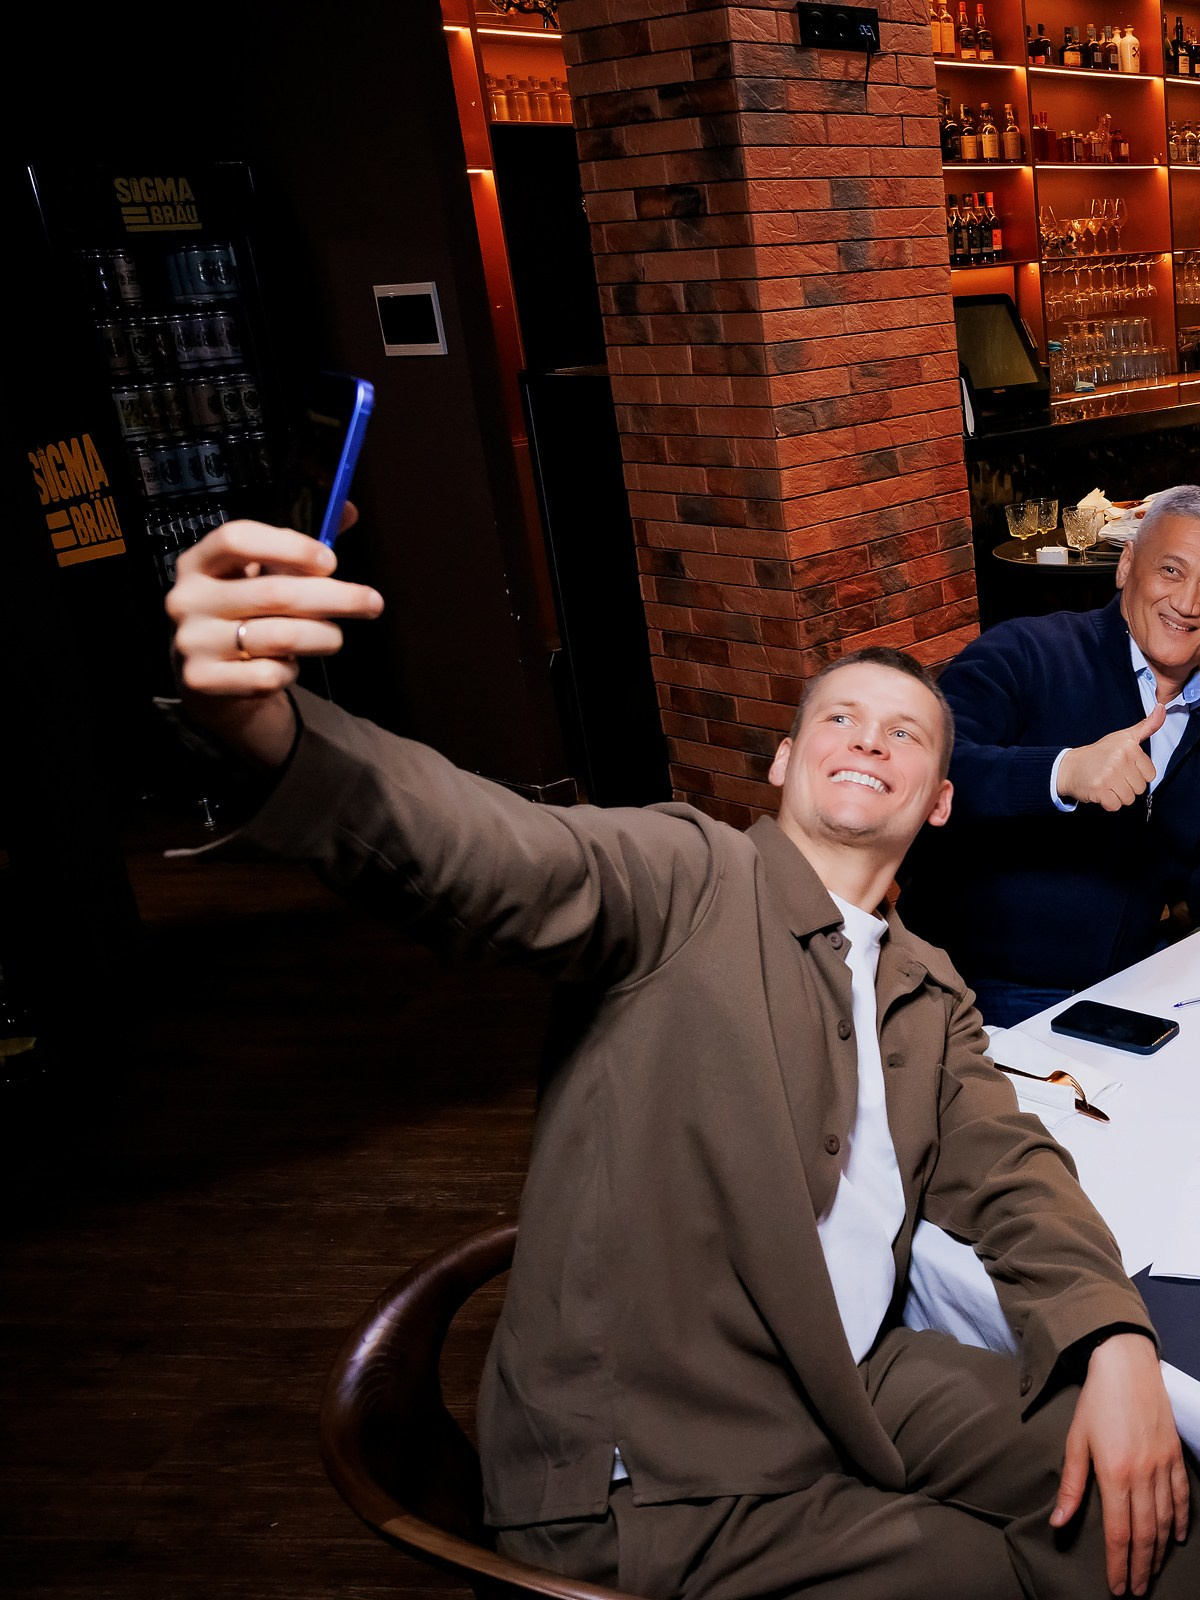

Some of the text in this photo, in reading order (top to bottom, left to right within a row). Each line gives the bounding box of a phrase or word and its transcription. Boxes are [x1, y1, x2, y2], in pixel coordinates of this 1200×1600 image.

[113, 176, 196, 203] SIGMA
[28, 433, 109, 506] SIGMA
[69, 491, 122, 545] BRÄU
